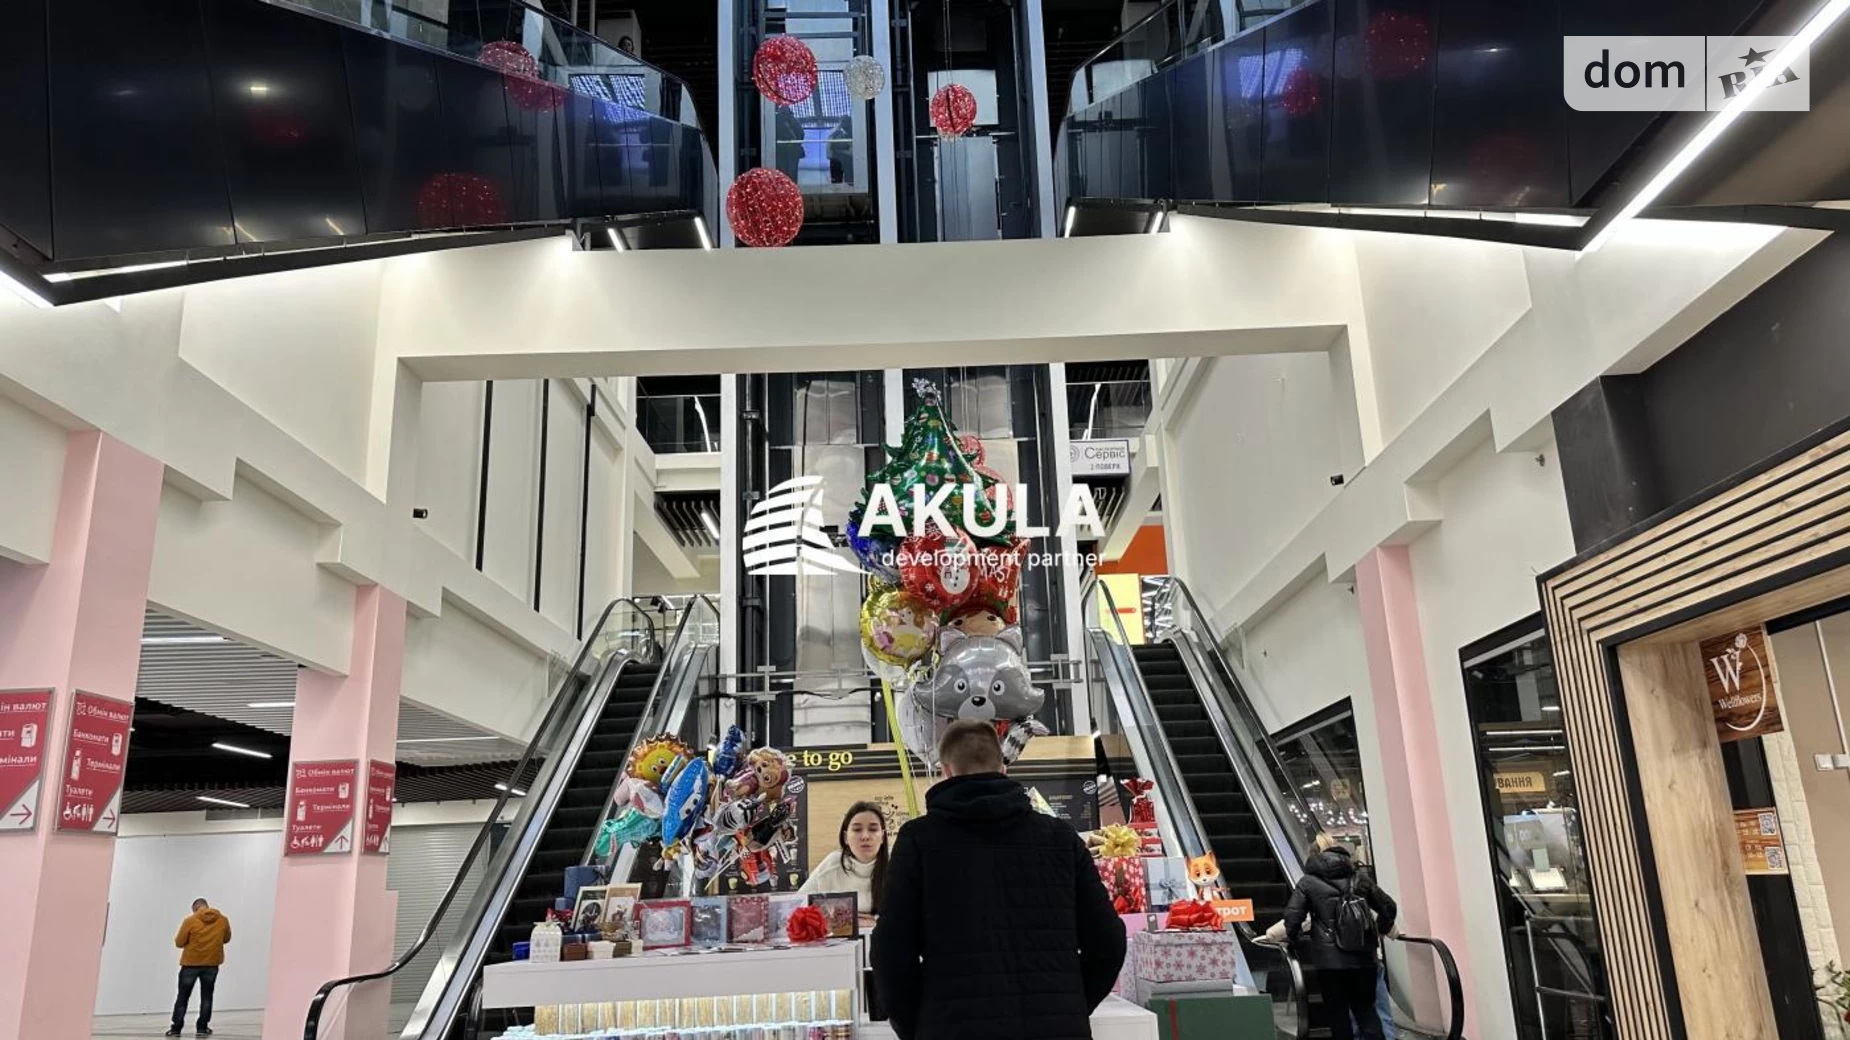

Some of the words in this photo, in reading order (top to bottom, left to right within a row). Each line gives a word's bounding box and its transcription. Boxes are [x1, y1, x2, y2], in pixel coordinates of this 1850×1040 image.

[1084, 447, 1125, 461] Сервіс
[12, 702, 48, 711] валют
[1719, 693, 1762, 710] Wellflowers
[87, 706, 108, 717] Обмін
[109, 712, 129, 720] валют
[73, 729, 109, 743] Банкомати
[87, 758, 121, 771] Термінали
[803, 750, 822, 766] to
[828, 751, 853, 771] go
[65, 785, 93, 796] Туалети
